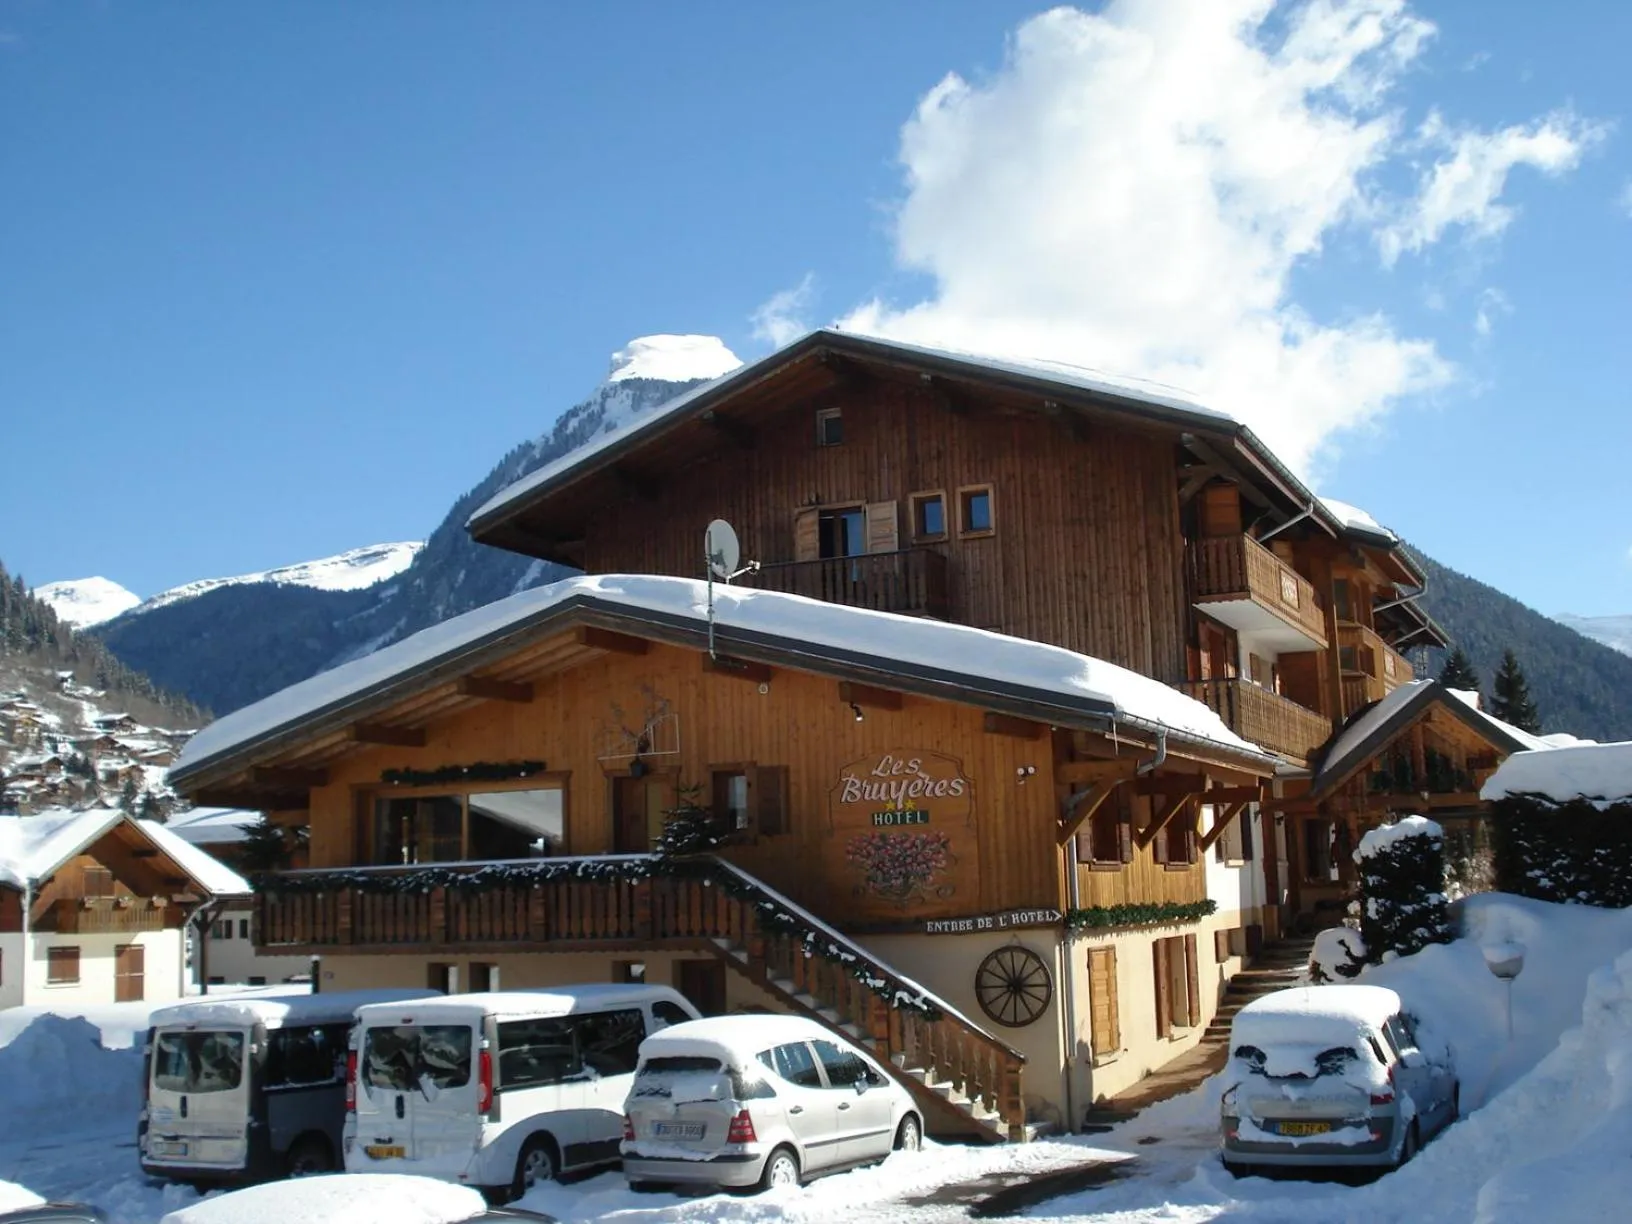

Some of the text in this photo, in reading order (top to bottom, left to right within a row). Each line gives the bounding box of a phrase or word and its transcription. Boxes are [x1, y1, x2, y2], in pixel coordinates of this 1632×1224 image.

[871, 755, 921, 777] Les
[874, 812, 924, 825] HOTEL
[926, 921, 973, 932] ENTREE
[977, 917, 993, 928] DE
[1011, 911, 1053, 925] HOTEL
